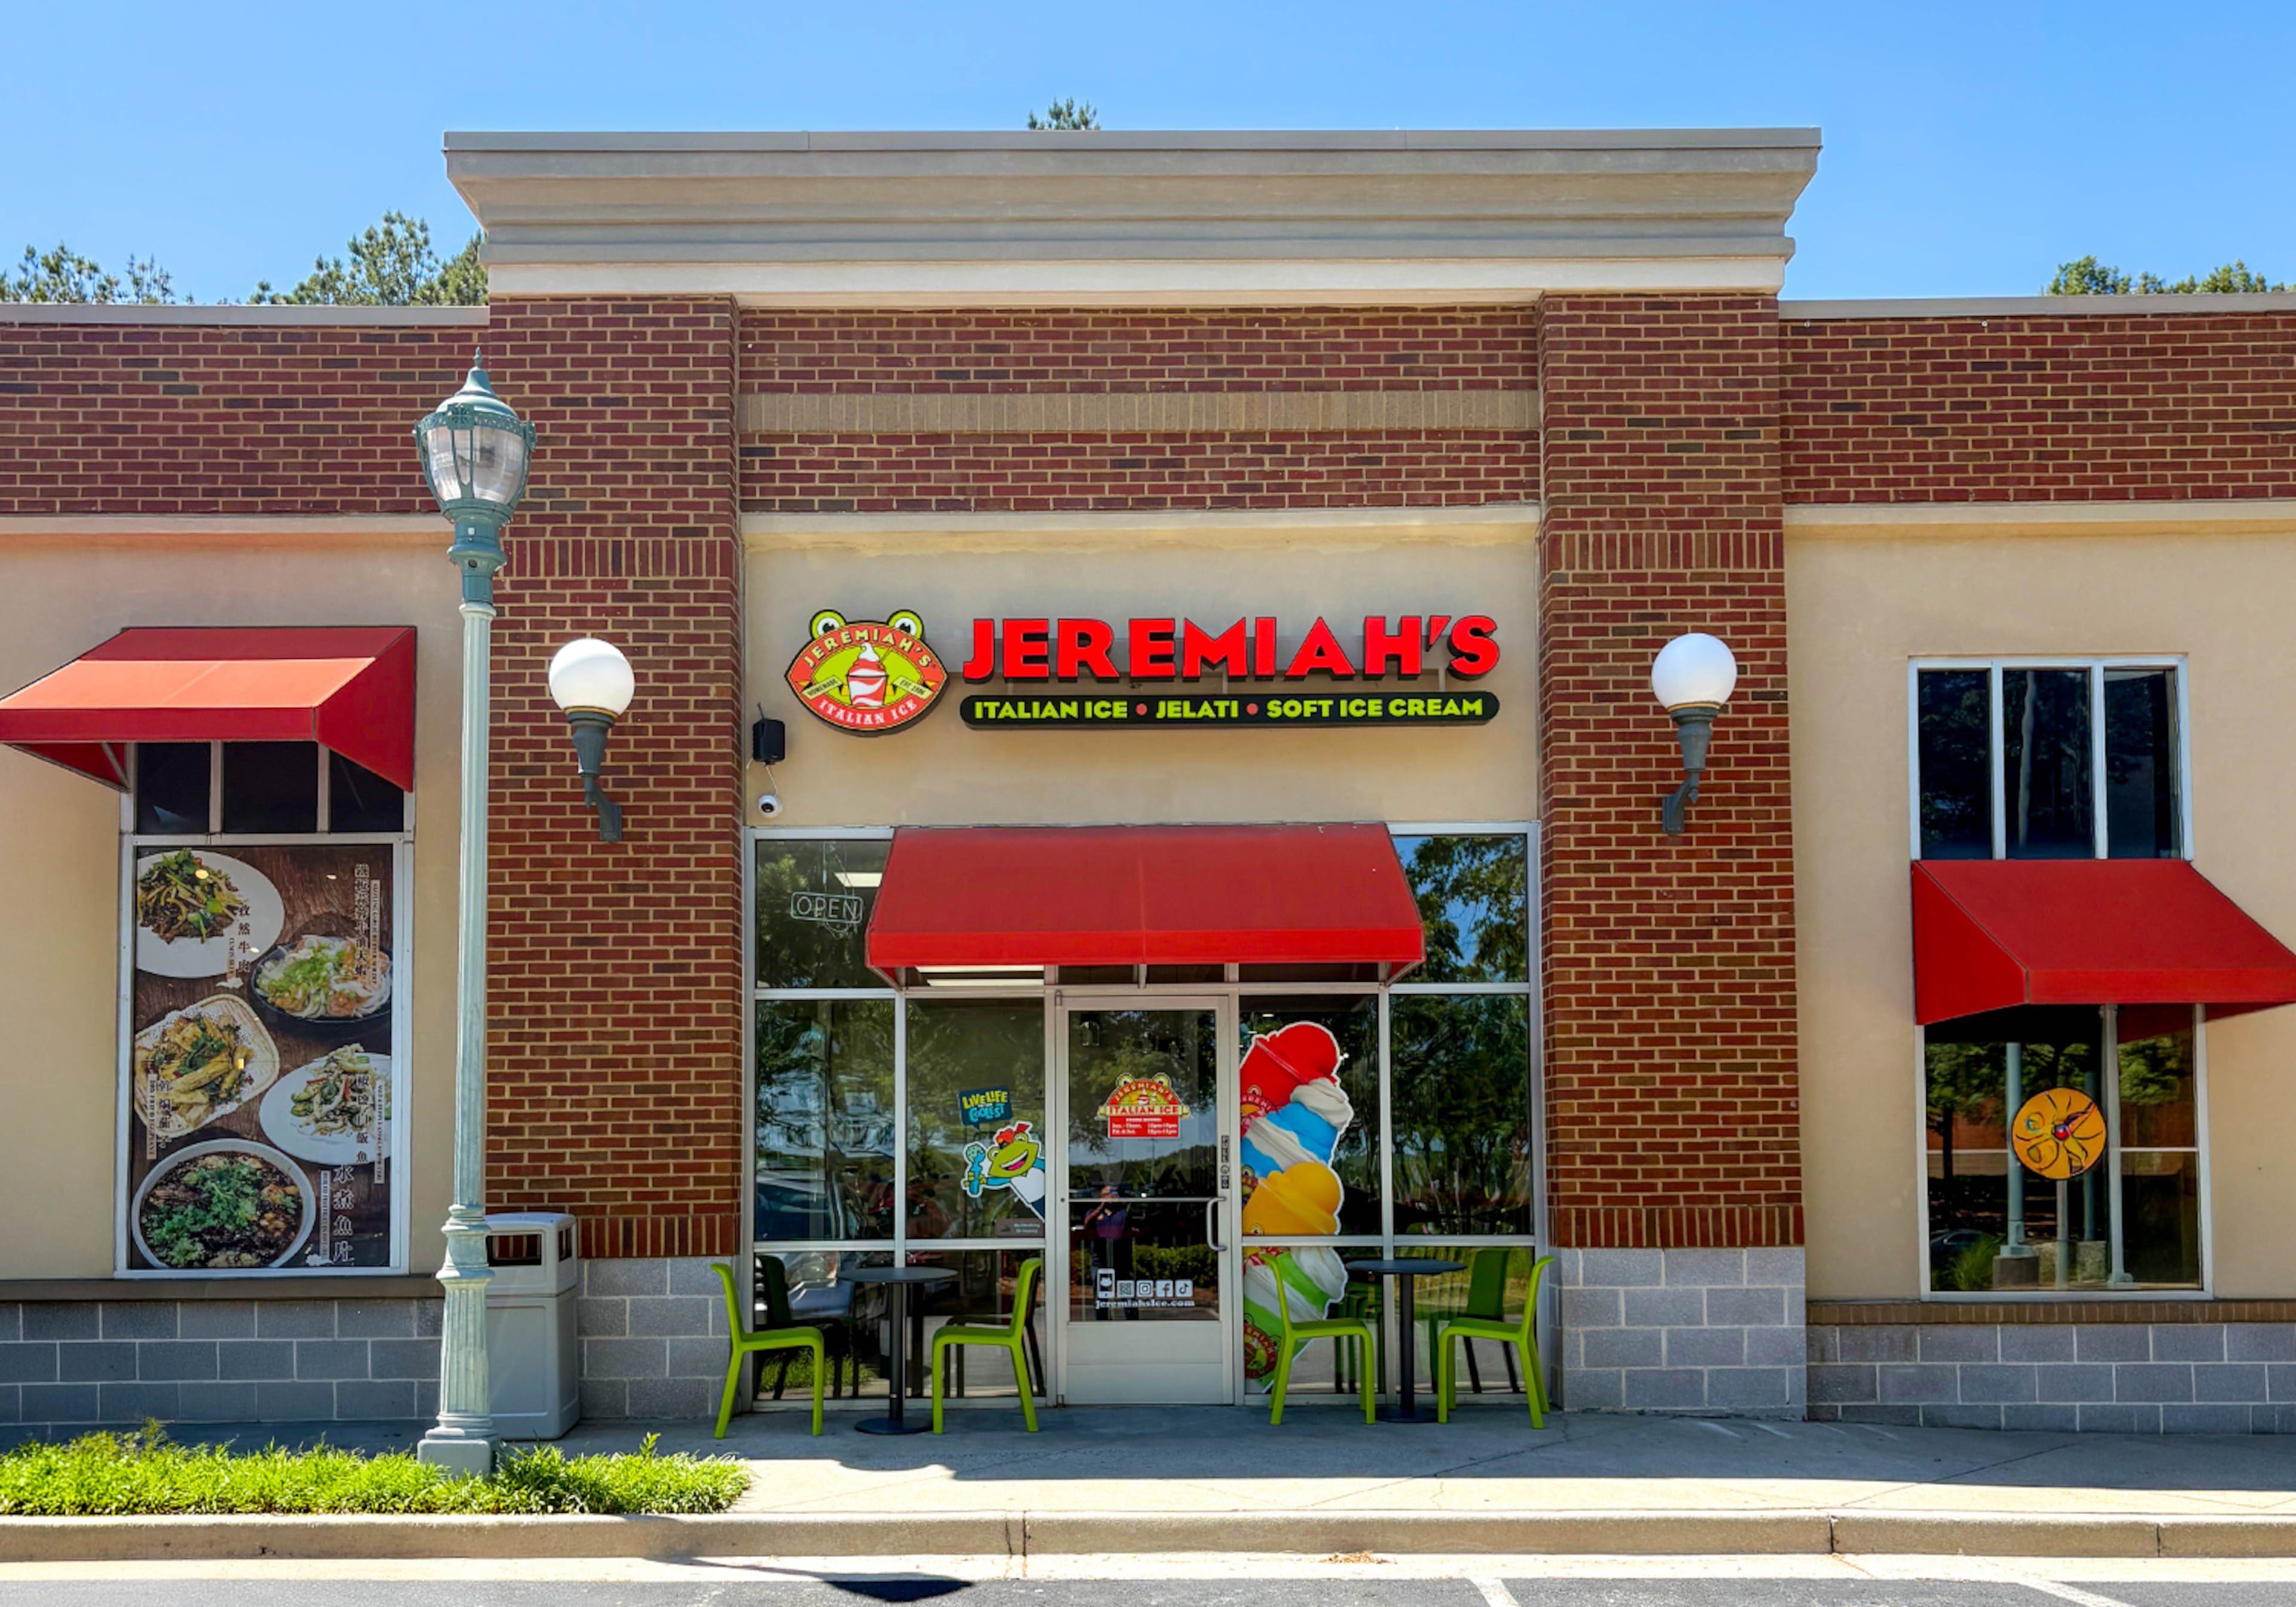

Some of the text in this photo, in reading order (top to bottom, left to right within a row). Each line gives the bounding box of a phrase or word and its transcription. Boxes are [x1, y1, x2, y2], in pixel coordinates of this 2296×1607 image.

[803, 628, 932, 669] JEREMIAH'S
[963, 615, 1500, 682] JEREMIAH'S
[819, 699, 917, 726] ITALIAN ICE
[974, 699, 1128, 720] ITALIAN ICE
[1155, 699, 1239, 719] JELATI
[1266, 698, 1483, 718] SOFT ICE CREAM
[796, 897, 857, 918] OPEN
[962, 1093, 985, 1110] LIVE
[1110, 1106, 1178, 1115] ITALIAN ICE
[969, 1102, 1005, 1123] COOLEST
